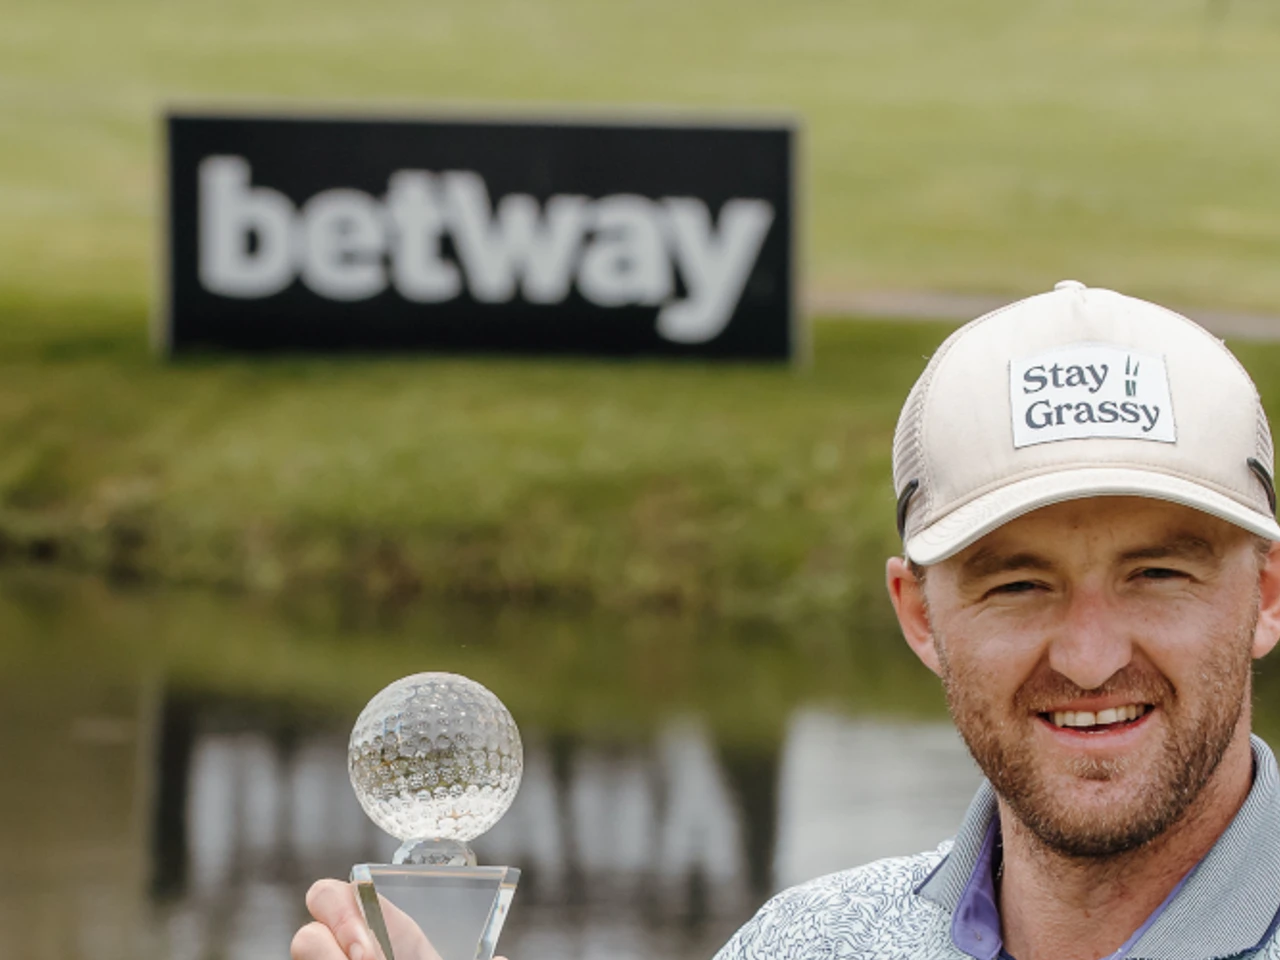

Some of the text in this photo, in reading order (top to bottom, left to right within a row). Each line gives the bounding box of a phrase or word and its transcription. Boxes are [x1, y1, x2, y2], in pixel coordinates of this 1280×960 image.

[199, 154, 775, 343] betway
[1023, 361, 1108, 394] Stay
[1025, 399, 1160, 432] Grassy
